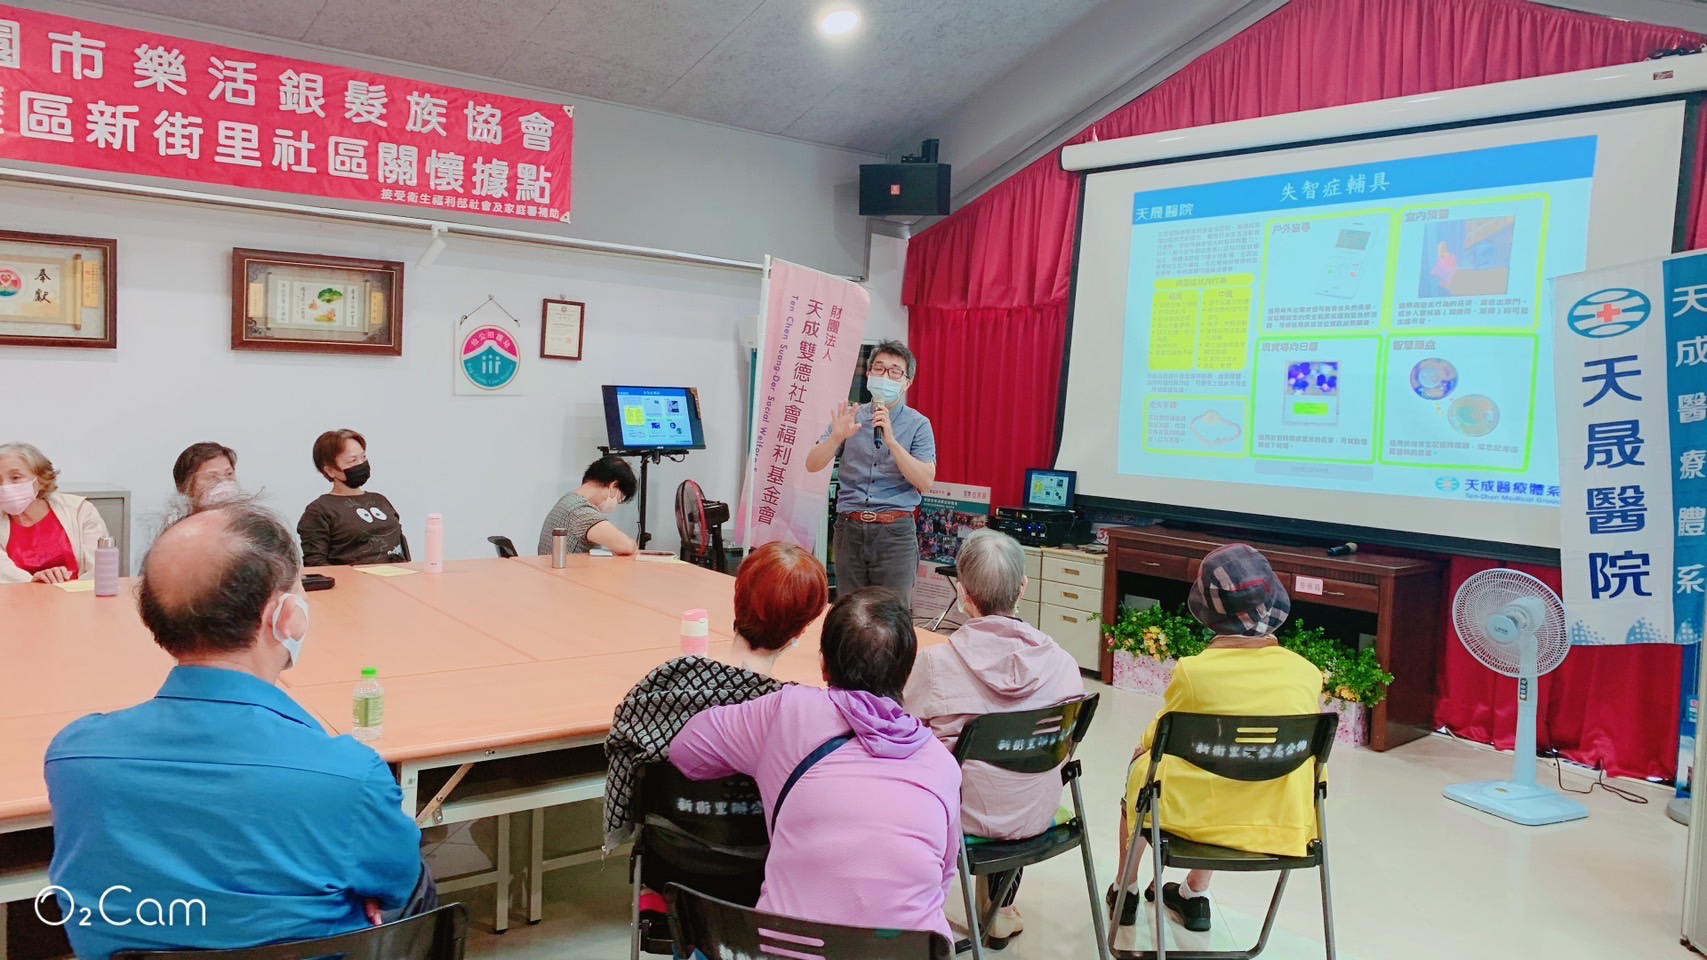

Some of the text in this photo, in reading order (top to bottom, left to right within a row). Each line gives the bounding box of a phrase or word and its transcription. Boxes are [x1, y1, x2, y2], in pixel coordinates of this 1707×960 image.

[0, 86, 551, 204] 區新街里社區關懷據點
[1280, 171, 1390, 201] 失智症輔具
[1135, 203, 1194, 221] 天晟醫院
[789, 295, 799, 312] Ten
[782, 316, 794, 340] Chen
[822, 305, 843, 362] 財團法人
[758, 299, 824, 526] 天成雙德社會福利基金會
[762, 396, 775, 423] Social
[1672, 284, 1707, 594] 天成醫療體系
[1465, 479, 1560, 497] 天成醫療體系
[1582, 355, 1653, 600] 天晟醫院
